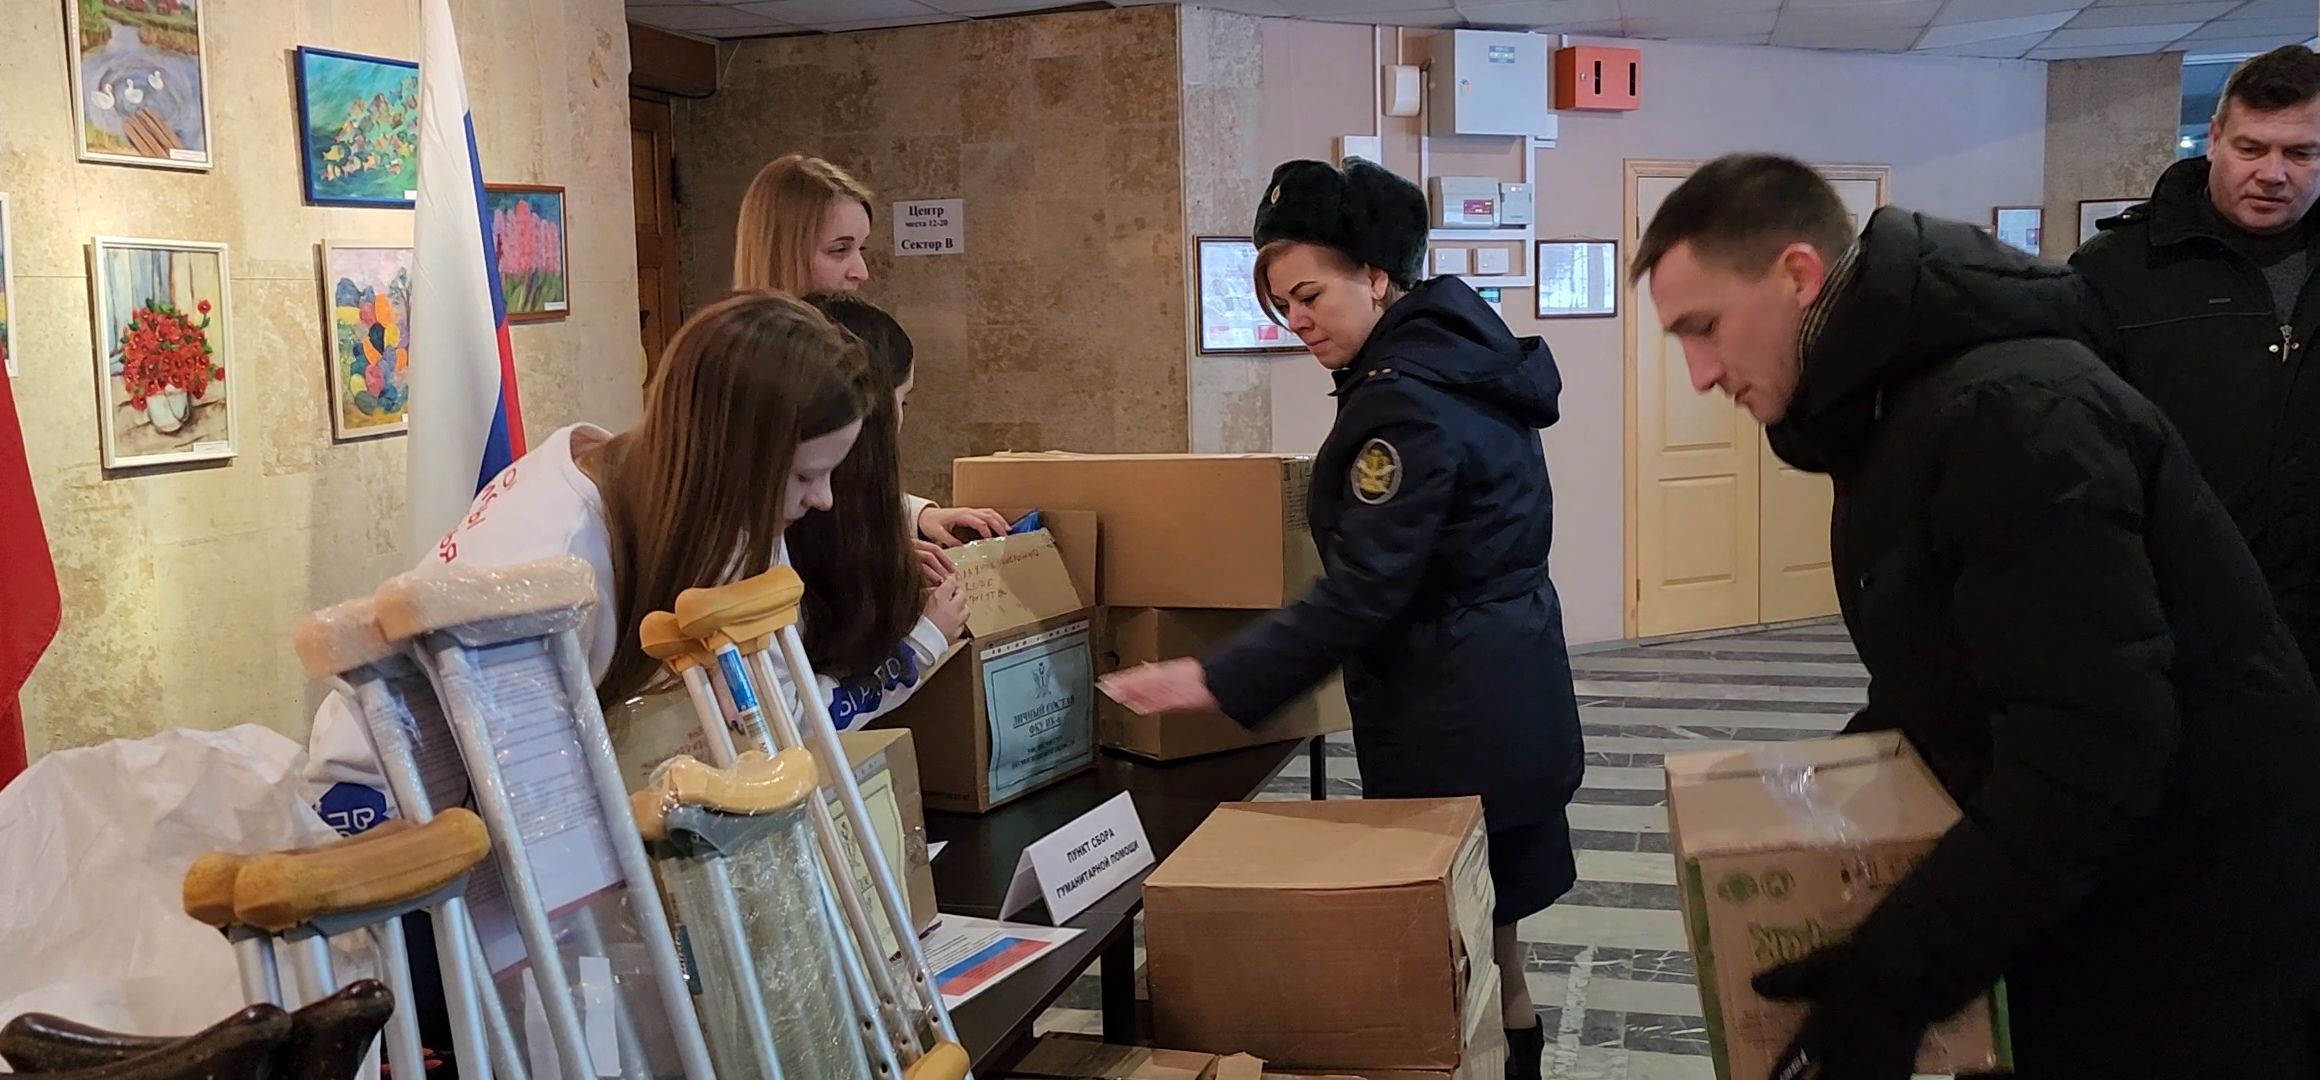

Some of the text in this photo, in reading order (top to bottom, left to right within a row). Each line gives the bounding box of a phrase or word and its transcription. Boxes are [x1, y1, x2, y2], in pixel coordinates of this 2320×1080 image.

[909, 206, 944, 217] Центр
[929, 219, 948, 227] 12-20
[901, 239, 942, 251] Сектор
[1013, 703, 1045, 727] ЛИЧНЫЙ
[1066, 828, 1115, 863] ПУНКТ СБОРА
[1056, 840, 1140, 899] ГУМАНИТАРНОЙ ПОМОЩИ
